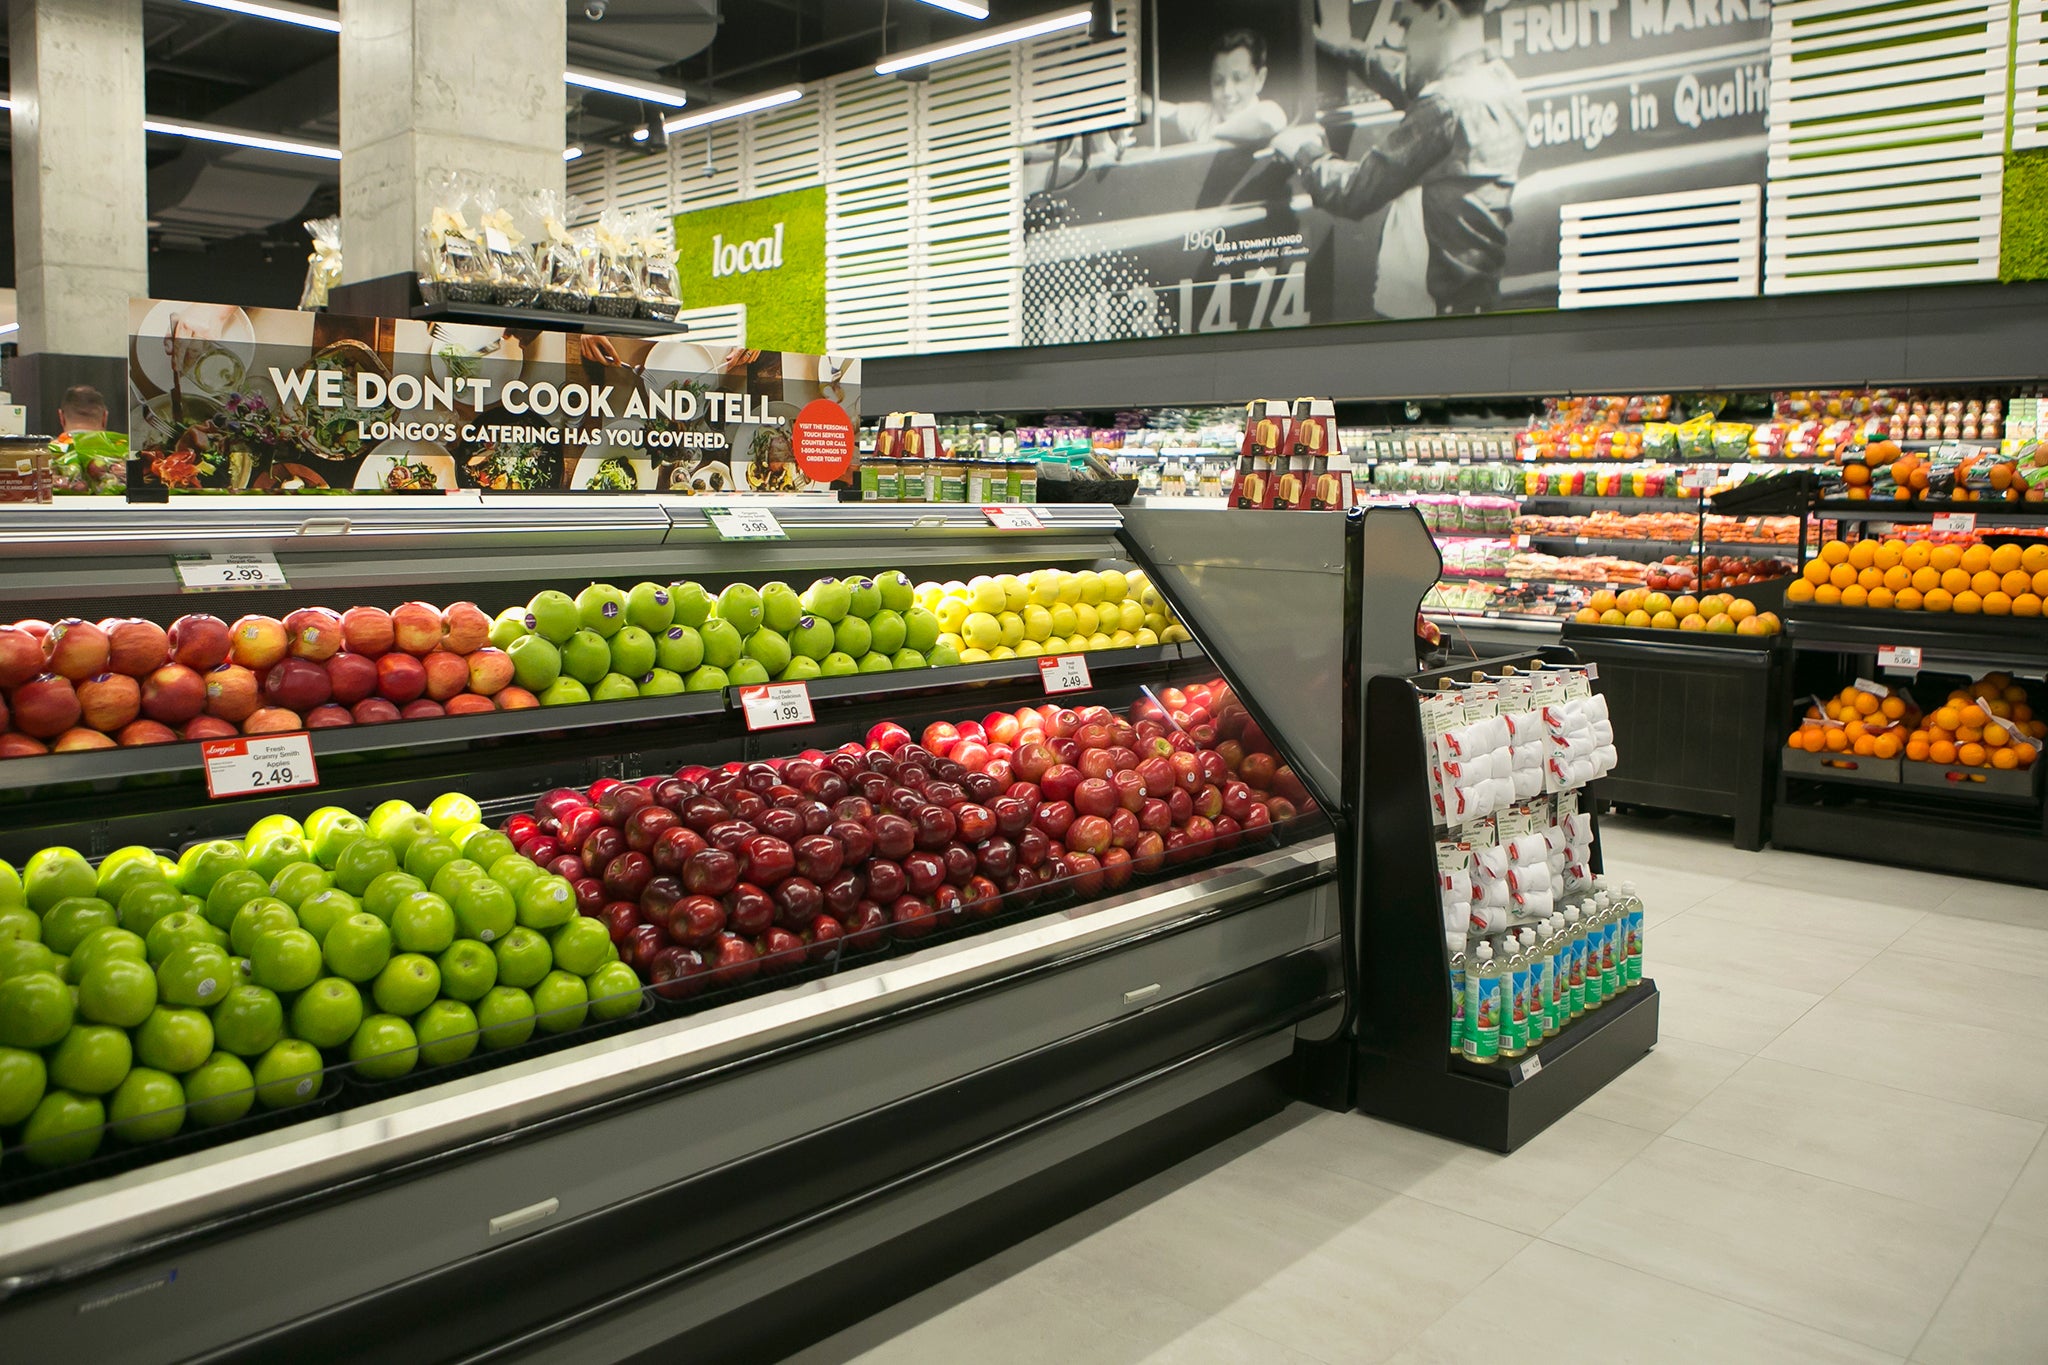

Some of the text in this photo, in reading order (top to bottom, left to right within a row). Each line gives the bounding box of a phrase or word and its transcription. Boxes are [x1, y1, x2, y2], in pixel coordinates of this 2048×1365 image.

[1501, 0, 1619, 58] FRUIT
[1629, 82, 1658, 131] in
[1182, 227, 1226, 251] 1960
[1239, 238, 1271, 249] TOMMY
[1272, 233, 1303, 245] LONGO
[712, 222, 784, 278] local
[268, 366, 786, 425] WE DON'T COOK AND TELL.
[358, 420, 729, 449] LONGO'S CATERING HAS YOU COVERED.
[741, 522, 768, 532] 3.99
[223, 569, 263, 581] 2.99
[1062, 675, 1081, 688] 2.49
[773, 706, 799, 721] 1.99
[253, 753, 278, 761] Granny
[265, 745, 286, 753] Fresh
[252, 767, 293, 787] 2.49
